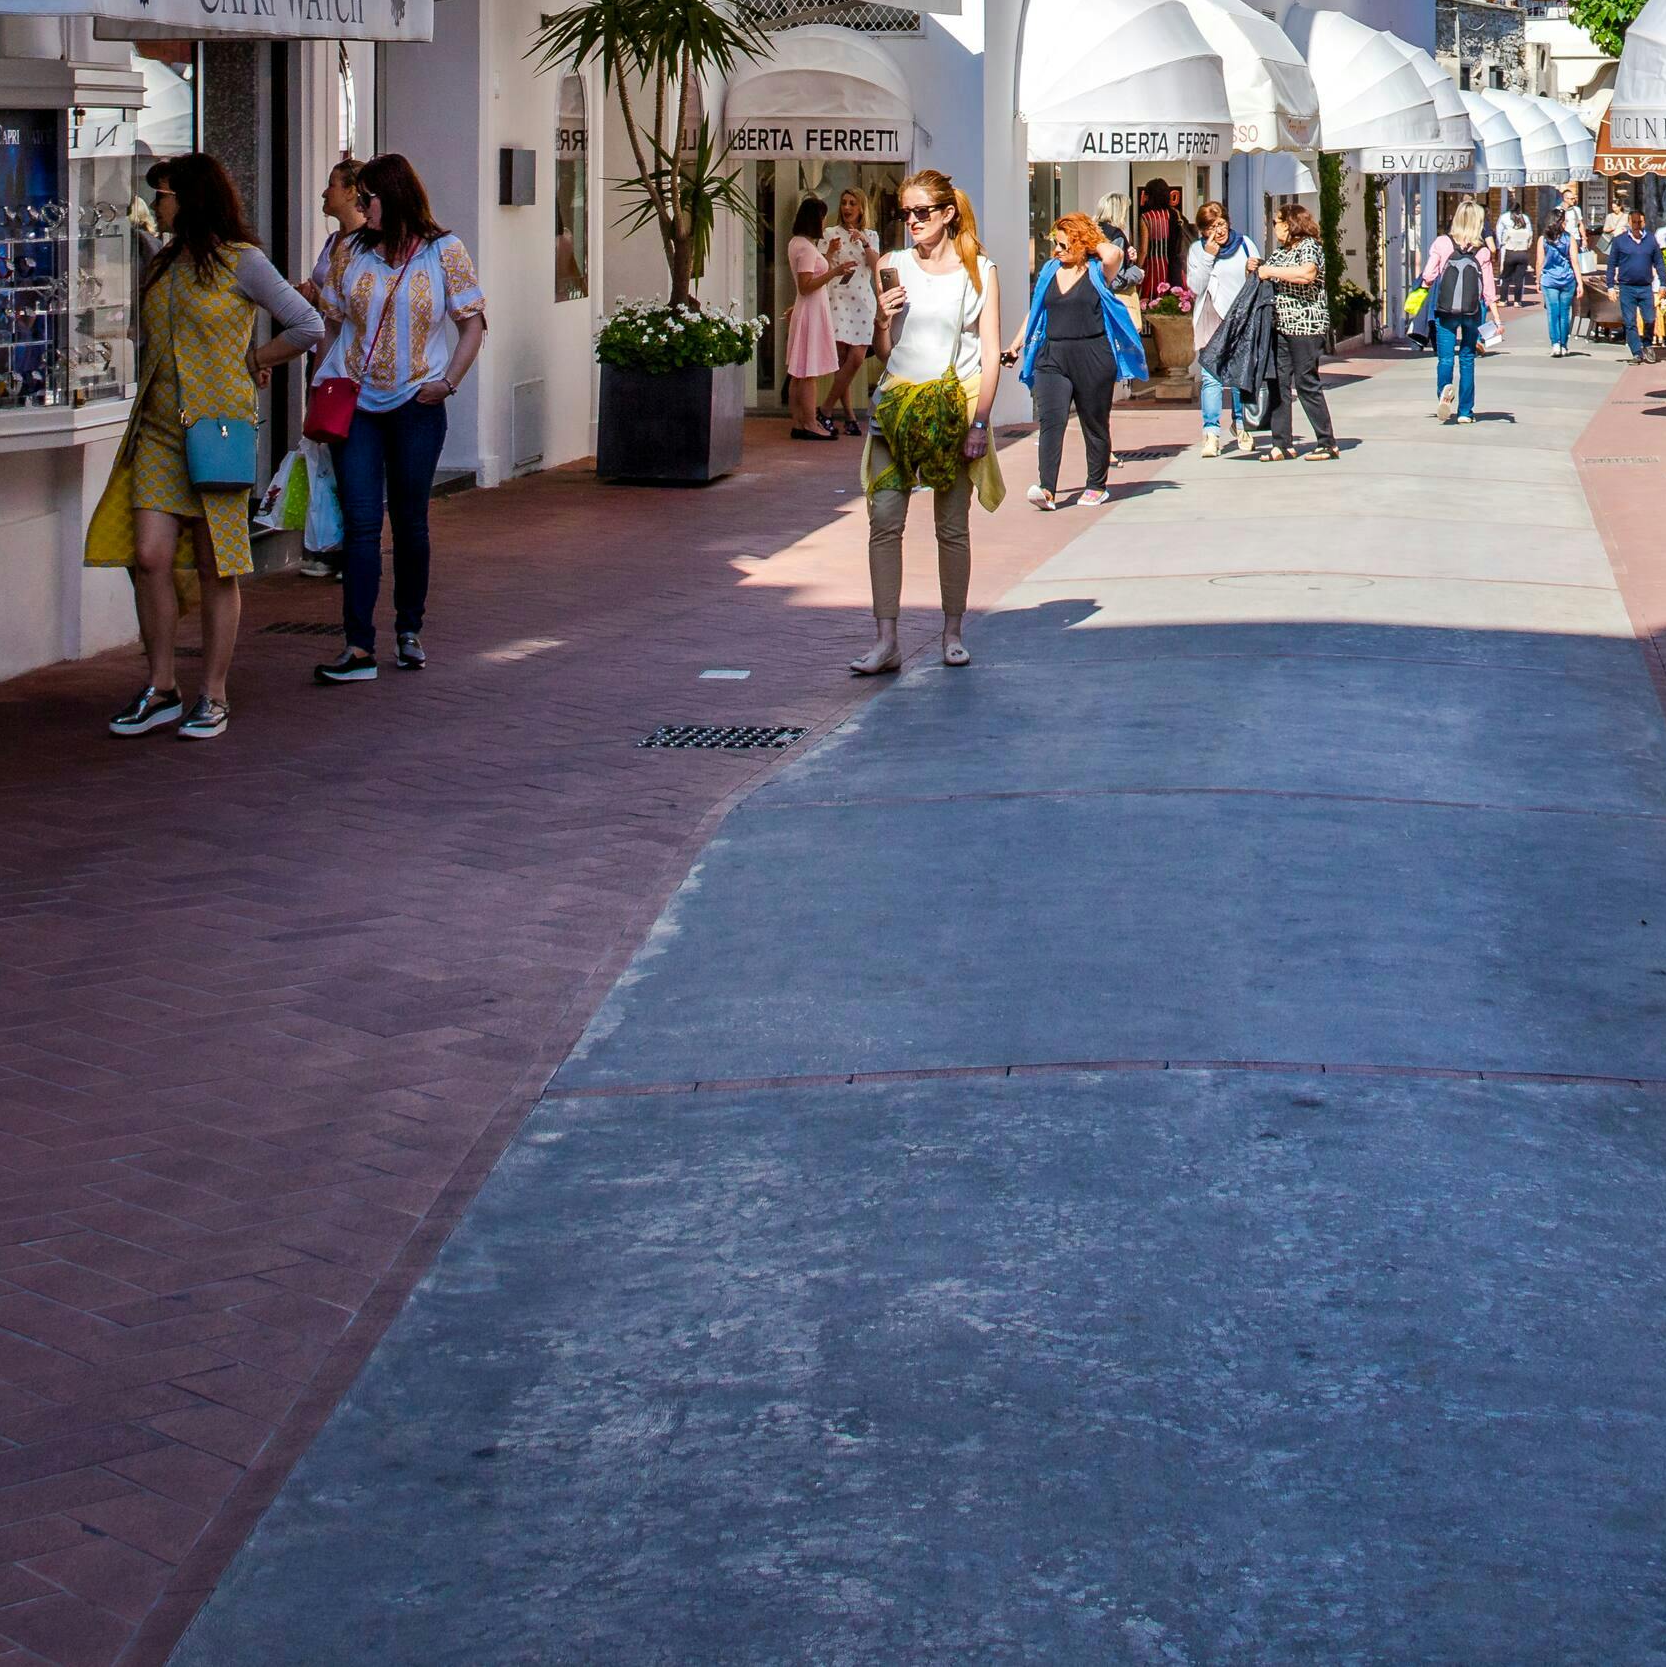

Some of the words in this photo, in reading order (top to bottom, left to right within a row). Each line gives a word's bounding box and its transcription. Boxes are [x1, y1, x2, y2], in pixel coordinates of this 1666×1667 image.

[727, 128, 794, 151] ALBERTA
[805, 129, 899, 153] FERRETTI
[1082, 132, 1169, 155] ALBERTA
[1177, 133, 1220, 155] FERRETTI
[1382, 155, 1472, 170] BVLGARI
[1603, 157, 1637, 171] BAR
